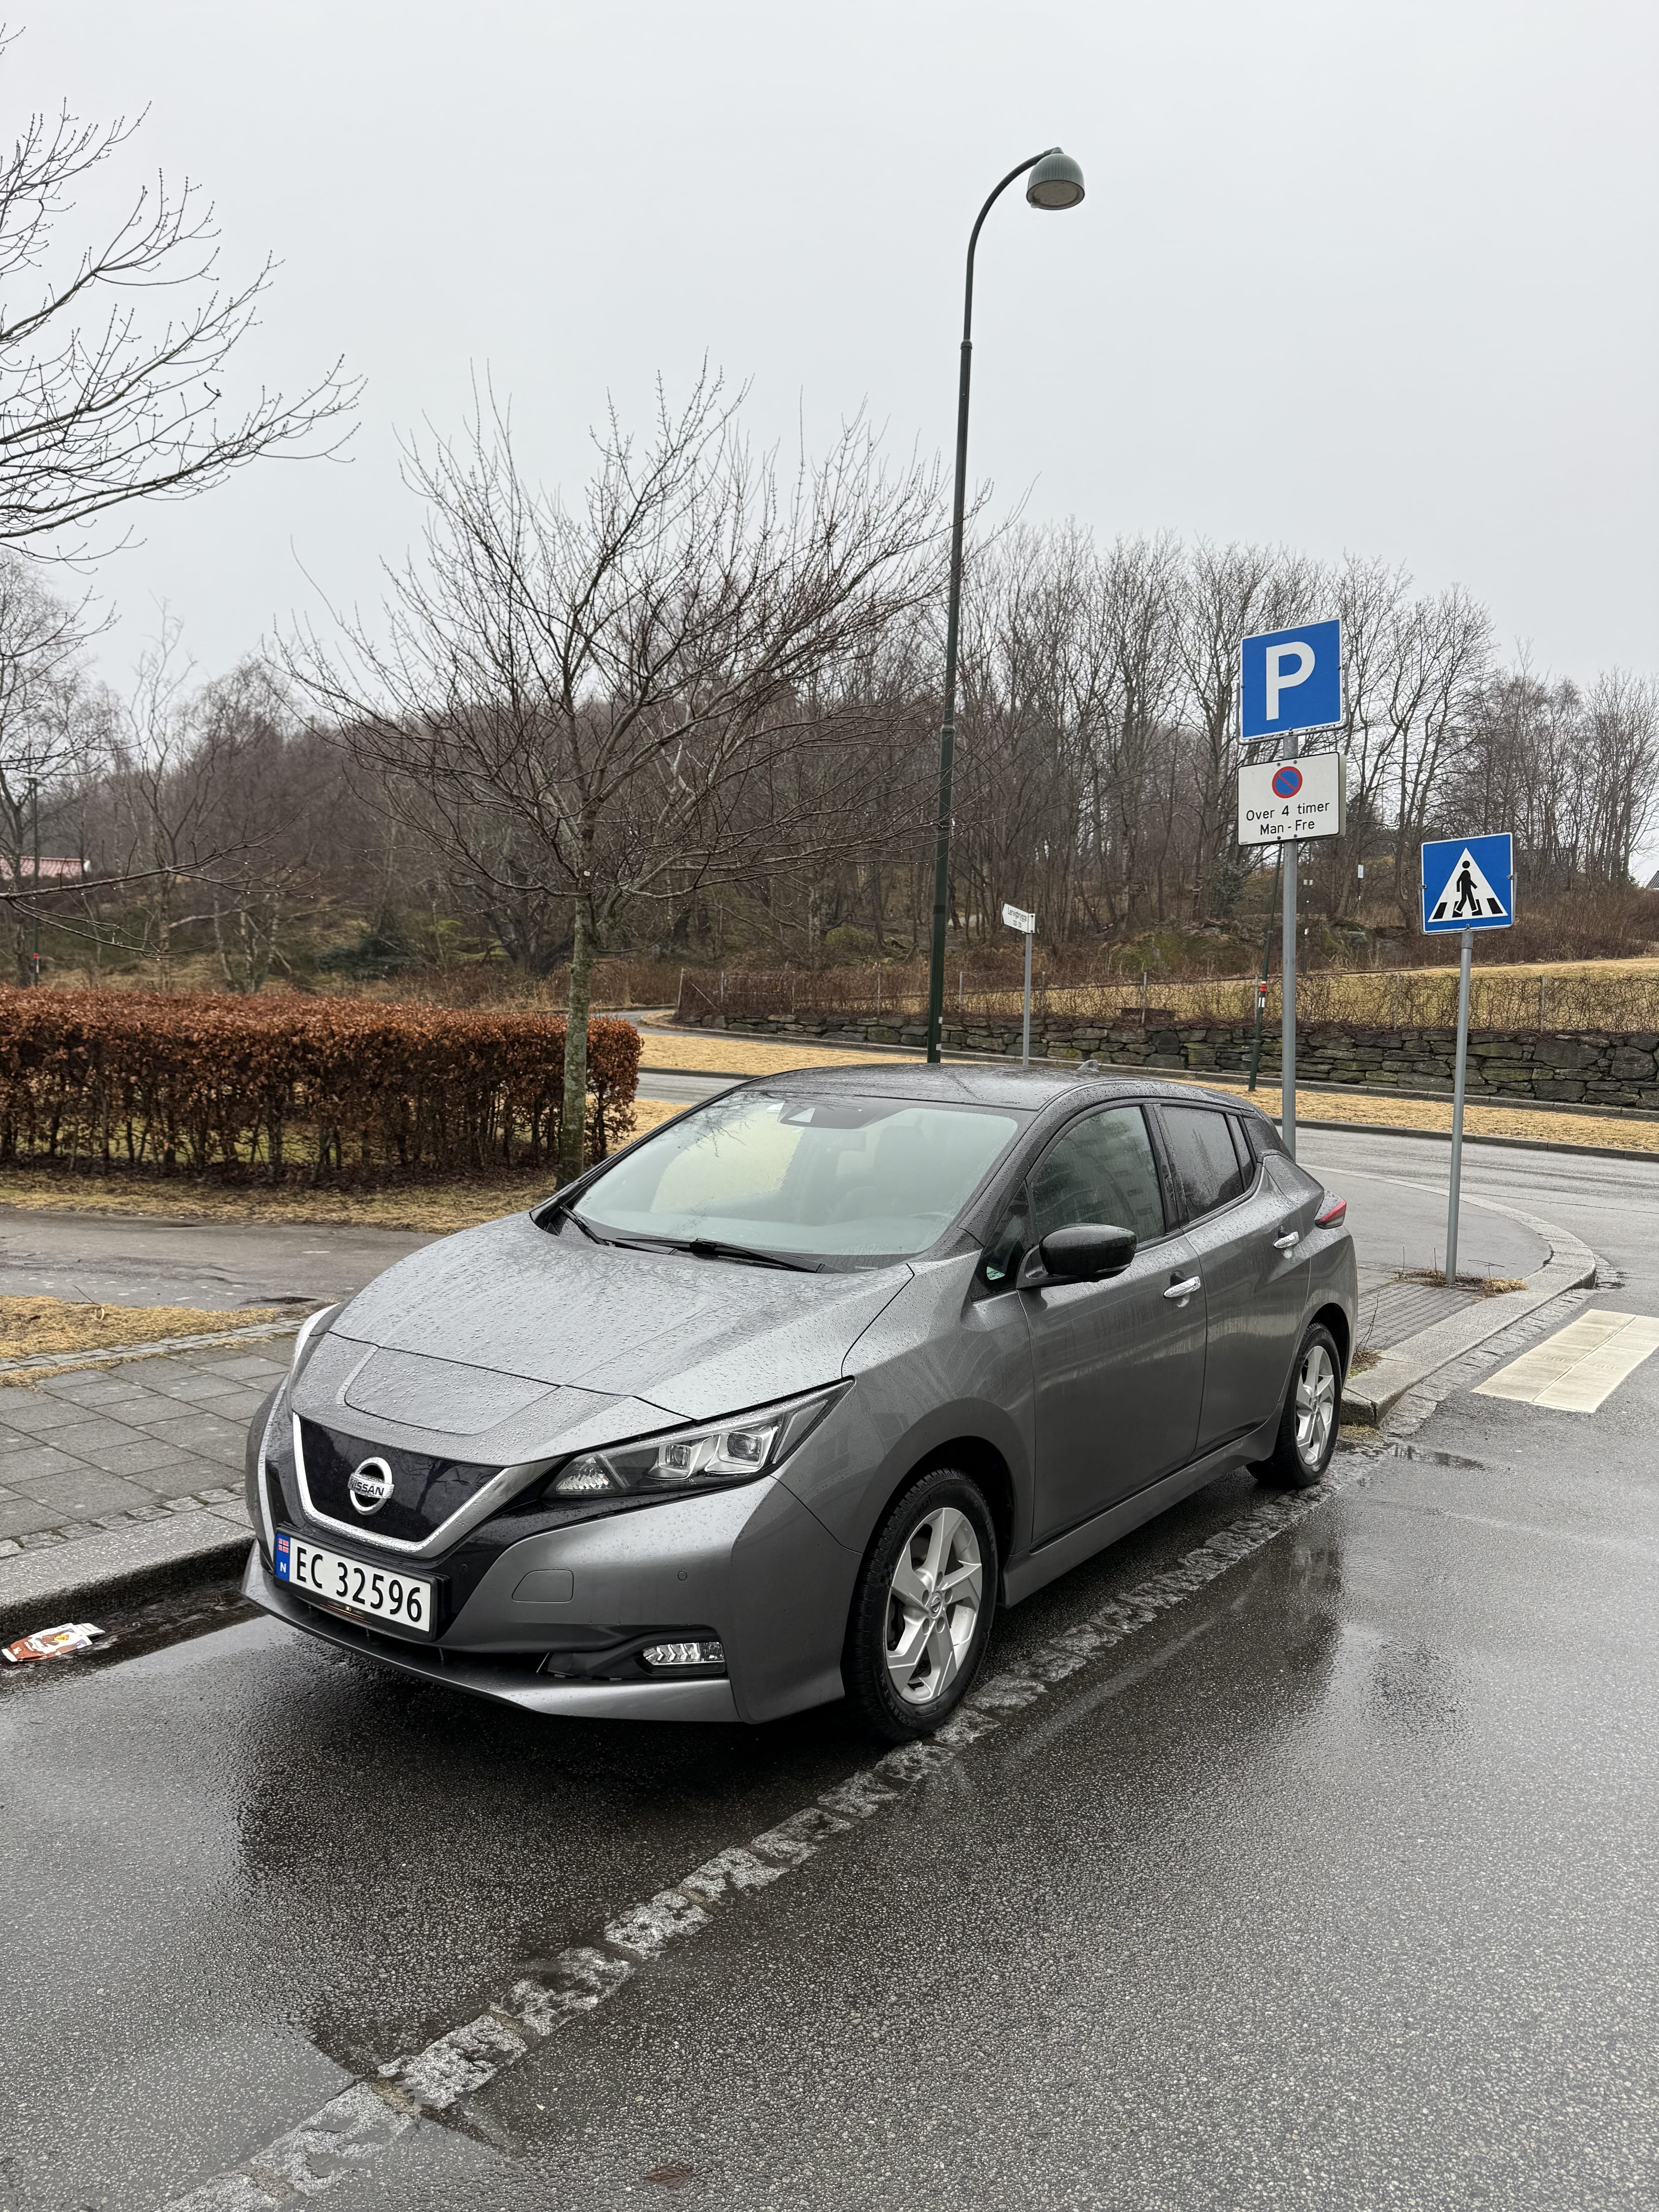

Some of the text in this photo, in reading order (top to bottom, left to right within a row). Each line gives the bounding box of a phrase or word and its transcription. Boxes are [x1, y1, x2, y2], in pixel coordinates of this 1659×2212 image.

[1266, 641, 1315, 721] P
[1246, 802, 1330, 821] Over 4 timer
[1260, 823, 1284, 835] Man
[1295, 819, 1315, 831] Fre
[350, 1478, 384, 1496] NISSAN
[280, 1561, 287, 1573] N
[297, 1546, 422, 1622] EC 32596
